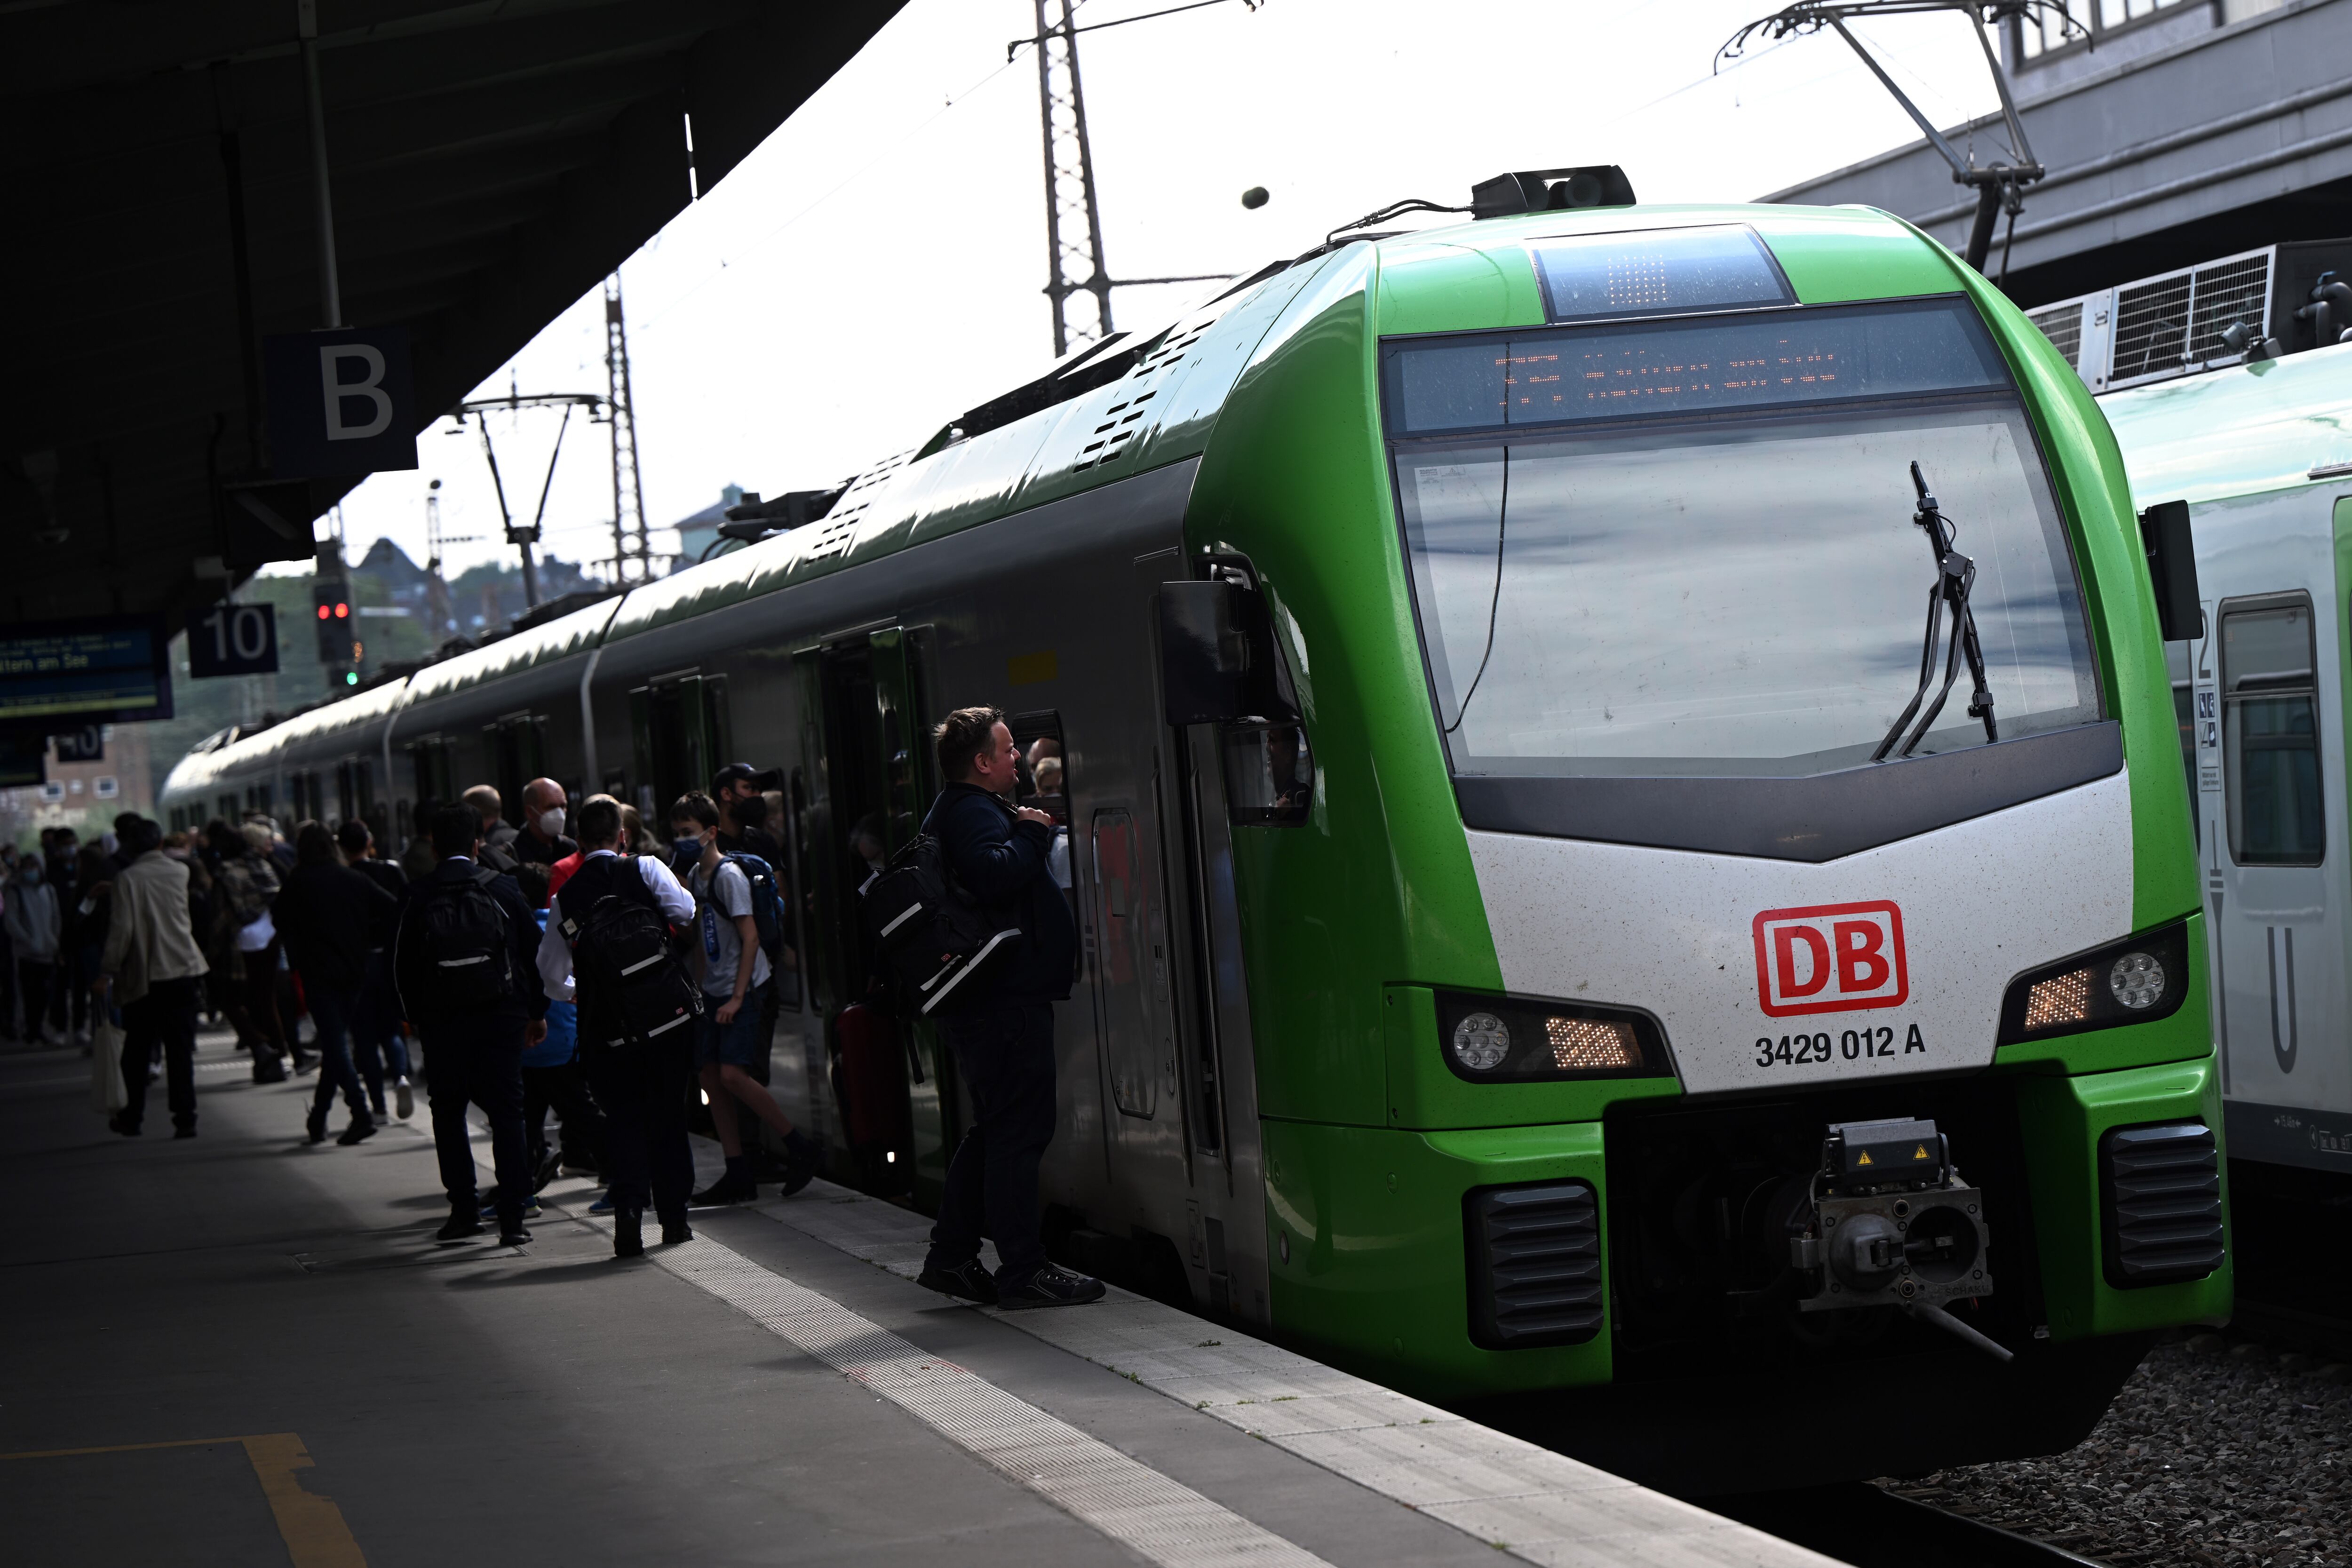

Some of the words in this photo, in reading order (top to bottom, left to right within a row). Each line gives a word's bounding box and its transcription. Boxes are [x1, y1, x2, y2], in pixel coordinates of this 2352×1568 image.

[319, 343, 394, 441] B
[37, 656, 60, 671] am
[62, 653, 89, 669] See
[202, 606, 268, 662] 10
[1773, 920, 1890, 998] DB
[1756, 1033, 1832, 1067] 3429
[1841, 1026, 1895, 1060] 012
[1905, 1024, 1926, 1054] A
